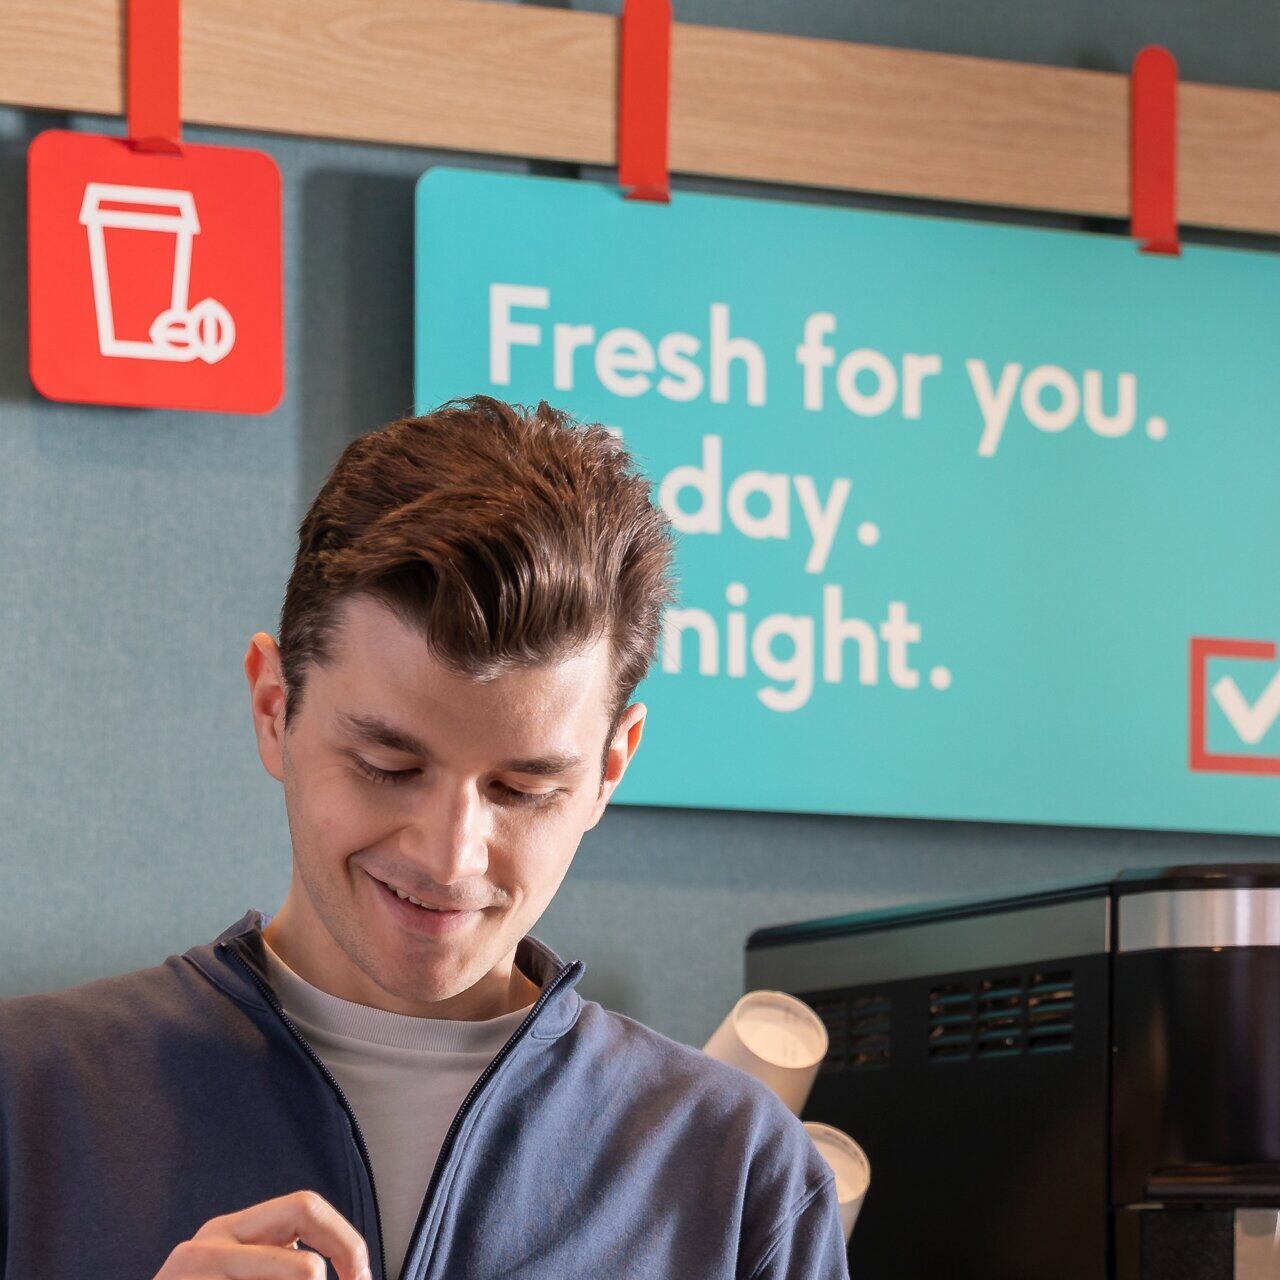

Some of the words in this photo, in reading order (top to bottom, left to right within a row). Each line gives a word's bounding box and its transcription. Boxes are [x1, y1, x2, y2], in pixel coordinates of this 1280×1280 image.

[488, 282, 767, 407] Fresh
[795, 312, 942, 420] for
[965, 357, 1168, 459] you.
[657, 433, 881, 574] day.
[661, 581, 953, 713] night.
